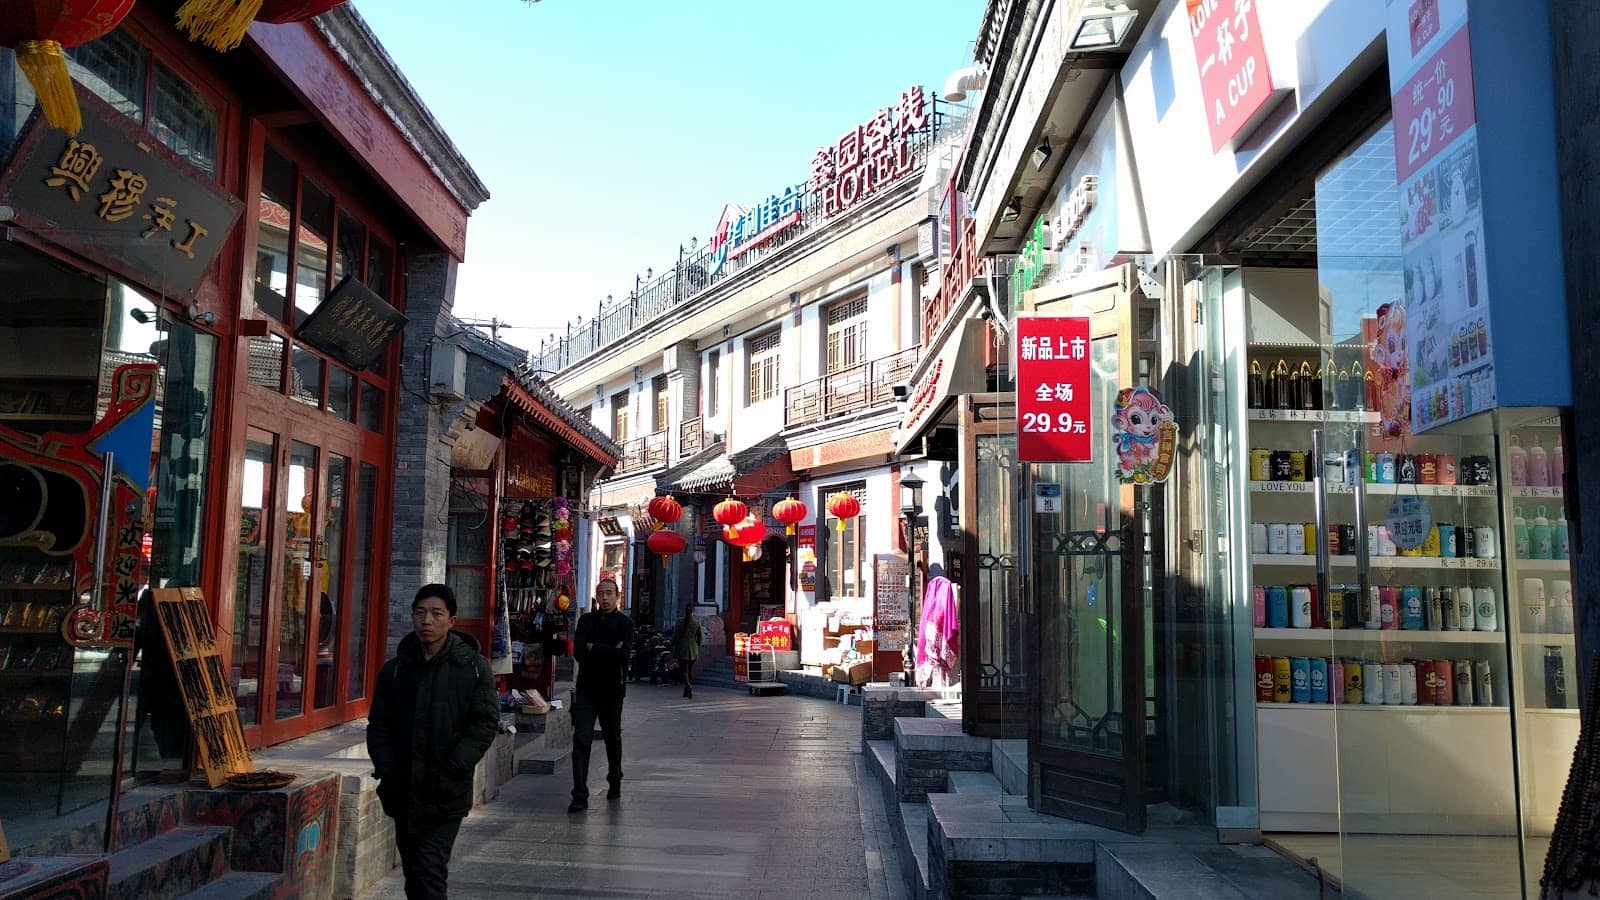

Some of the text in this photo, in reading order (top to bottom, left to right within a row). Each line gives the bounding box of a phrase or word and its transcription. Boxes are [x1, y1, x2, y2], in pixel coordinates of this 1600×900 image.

[1215, 55, 1255, 126] A CUP
[1413, 57, 1447, 106] 统一价
[822, 139, 916, 219] HOTEL
[1021, 336, 1087, 361] 新品上市
[1035, 382, 1073, 402] 全场
[113, 520, 143, 638] 欢迎光临
